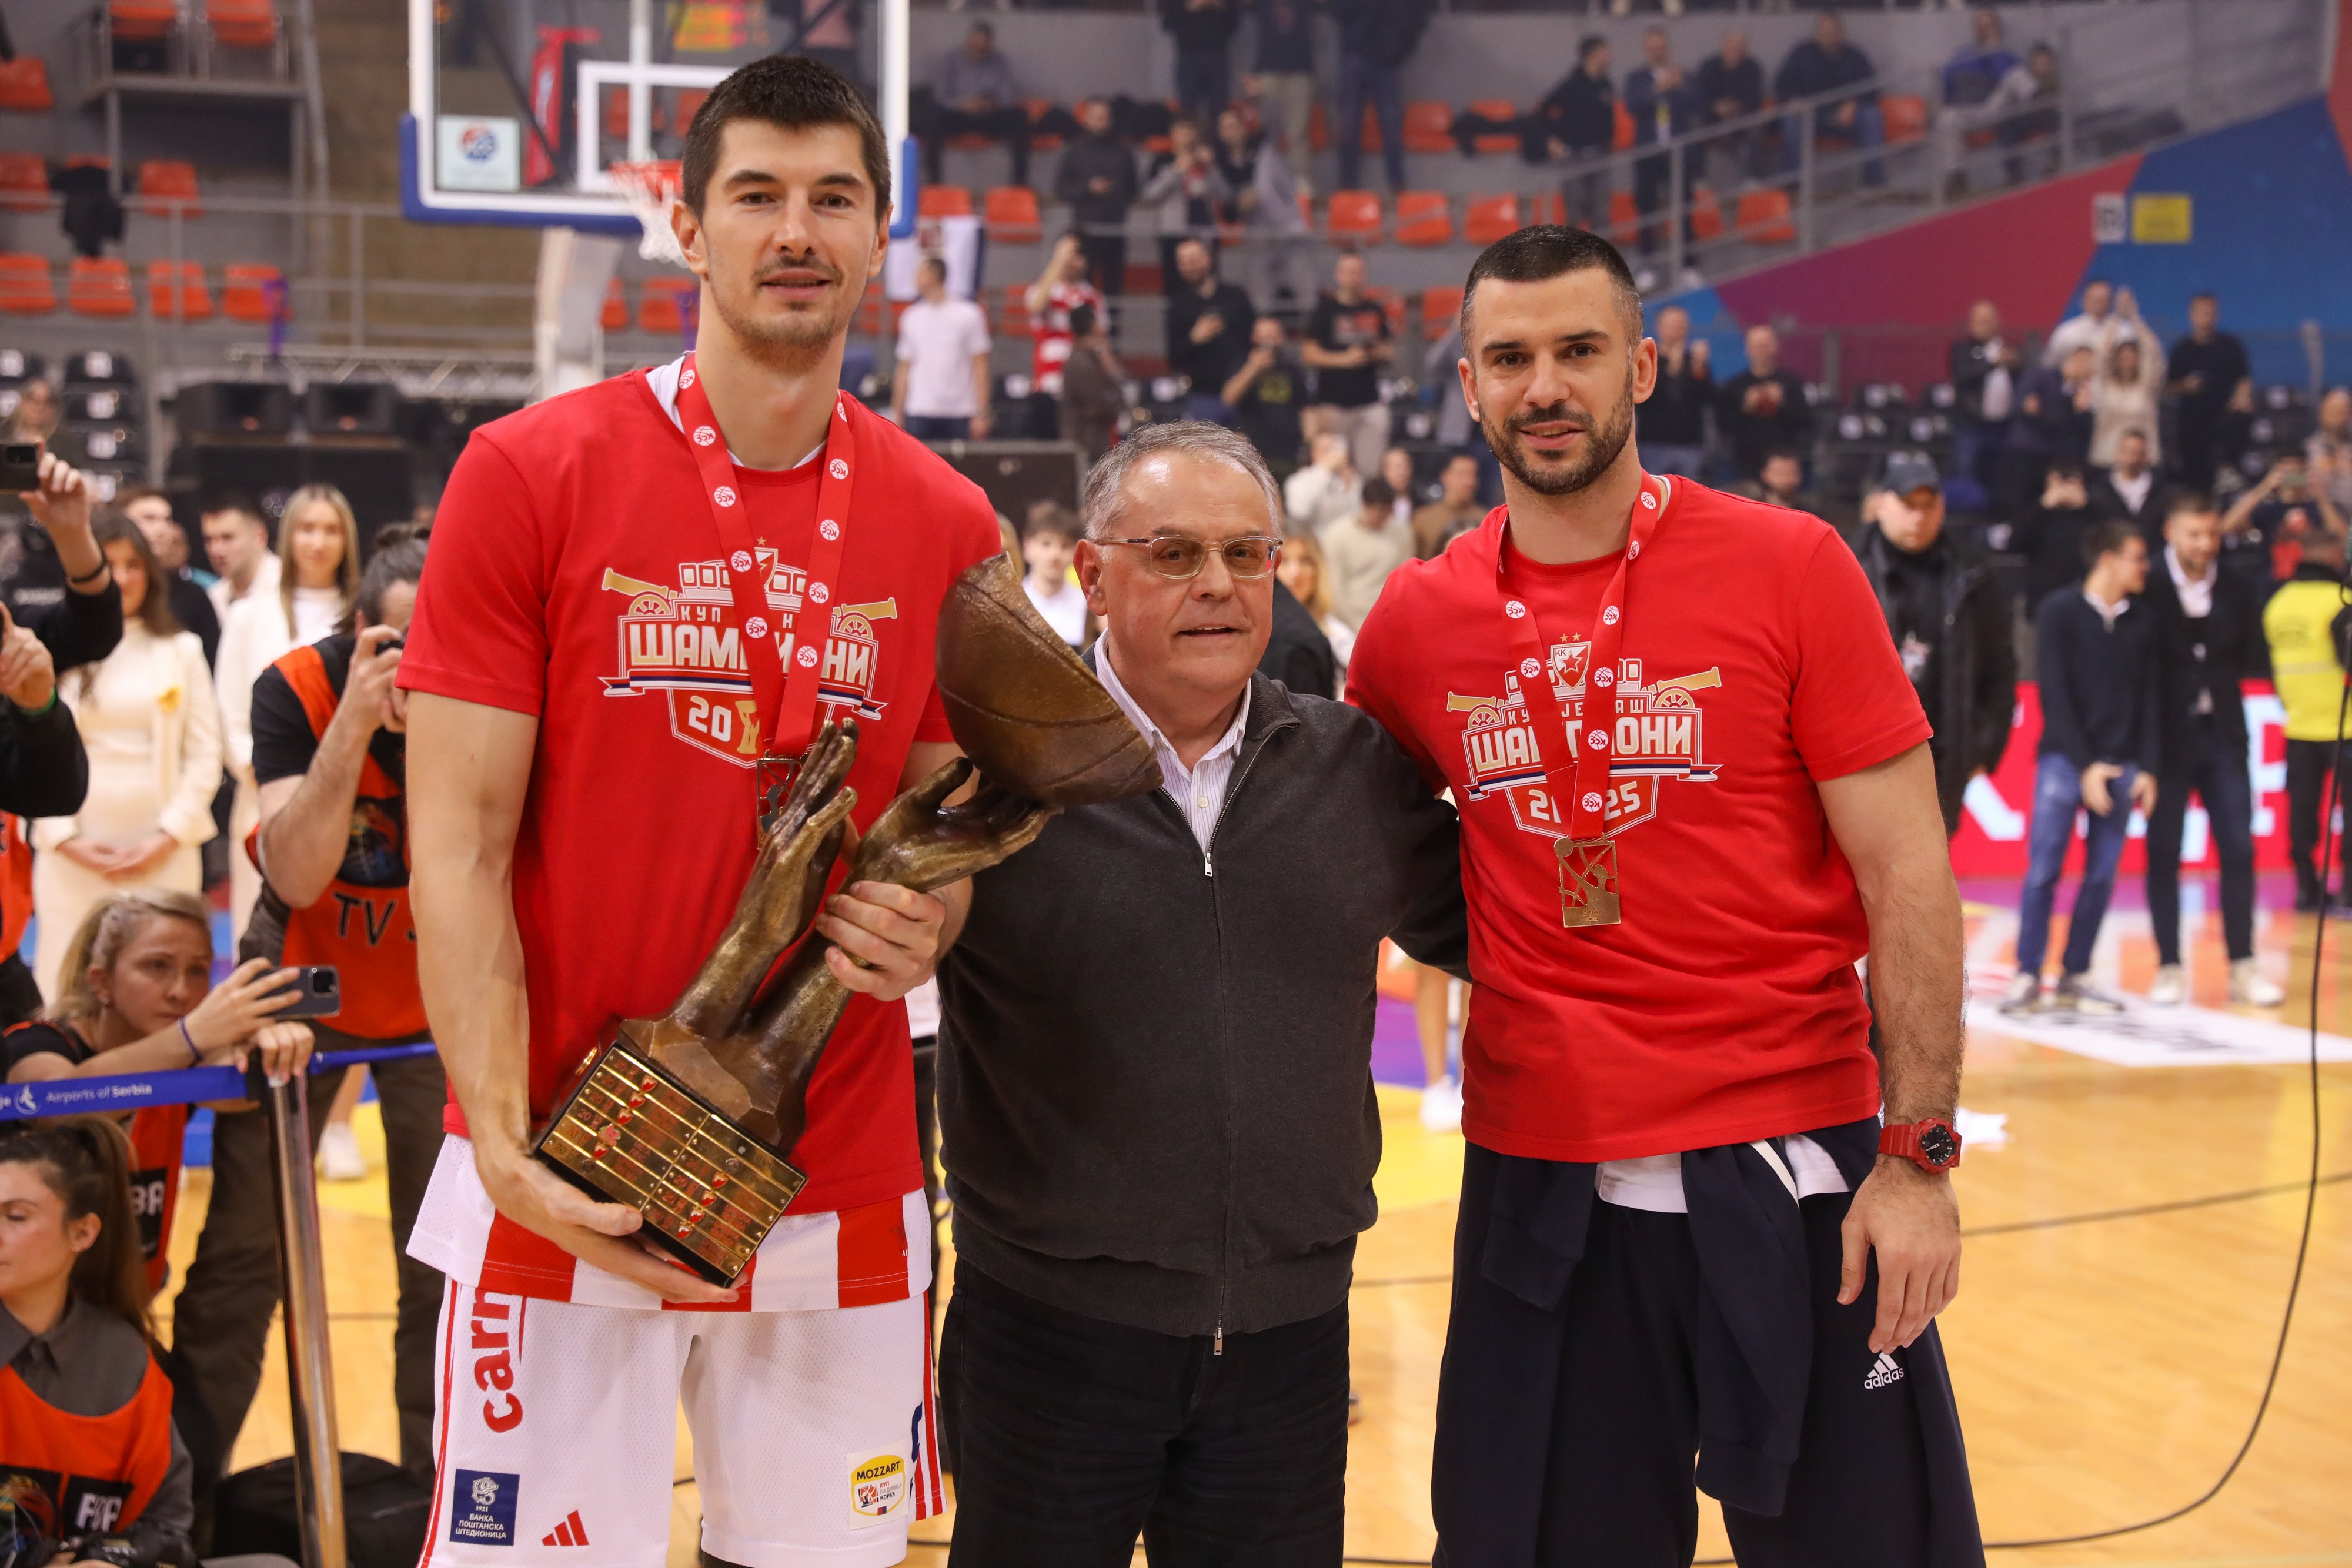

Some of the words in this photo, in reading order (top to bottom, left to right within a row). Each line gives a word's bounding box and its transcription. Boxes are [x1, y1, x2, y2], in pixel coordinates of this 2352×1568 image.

[681, 606, 721, 623] КУП
[334, 892, 397, 945] TV
[46, 1091, 96, 1105] Airports
[96, 1086, 110, 1099] of
[111, 1083, 153, 1098] Serbia
[1864, 1368, 1904, 1390] adidas
[857, 1460, 900, 1481] MOZZART
[880, 1491, 896, 1501] КОРАЋ
[459, 1520, 504, 1530] ПОШТАНСКА
[469, 1513, 493, 1522] БАНКА
[456, 1528, 506, 1539] ШТЕДИОНИЦА
